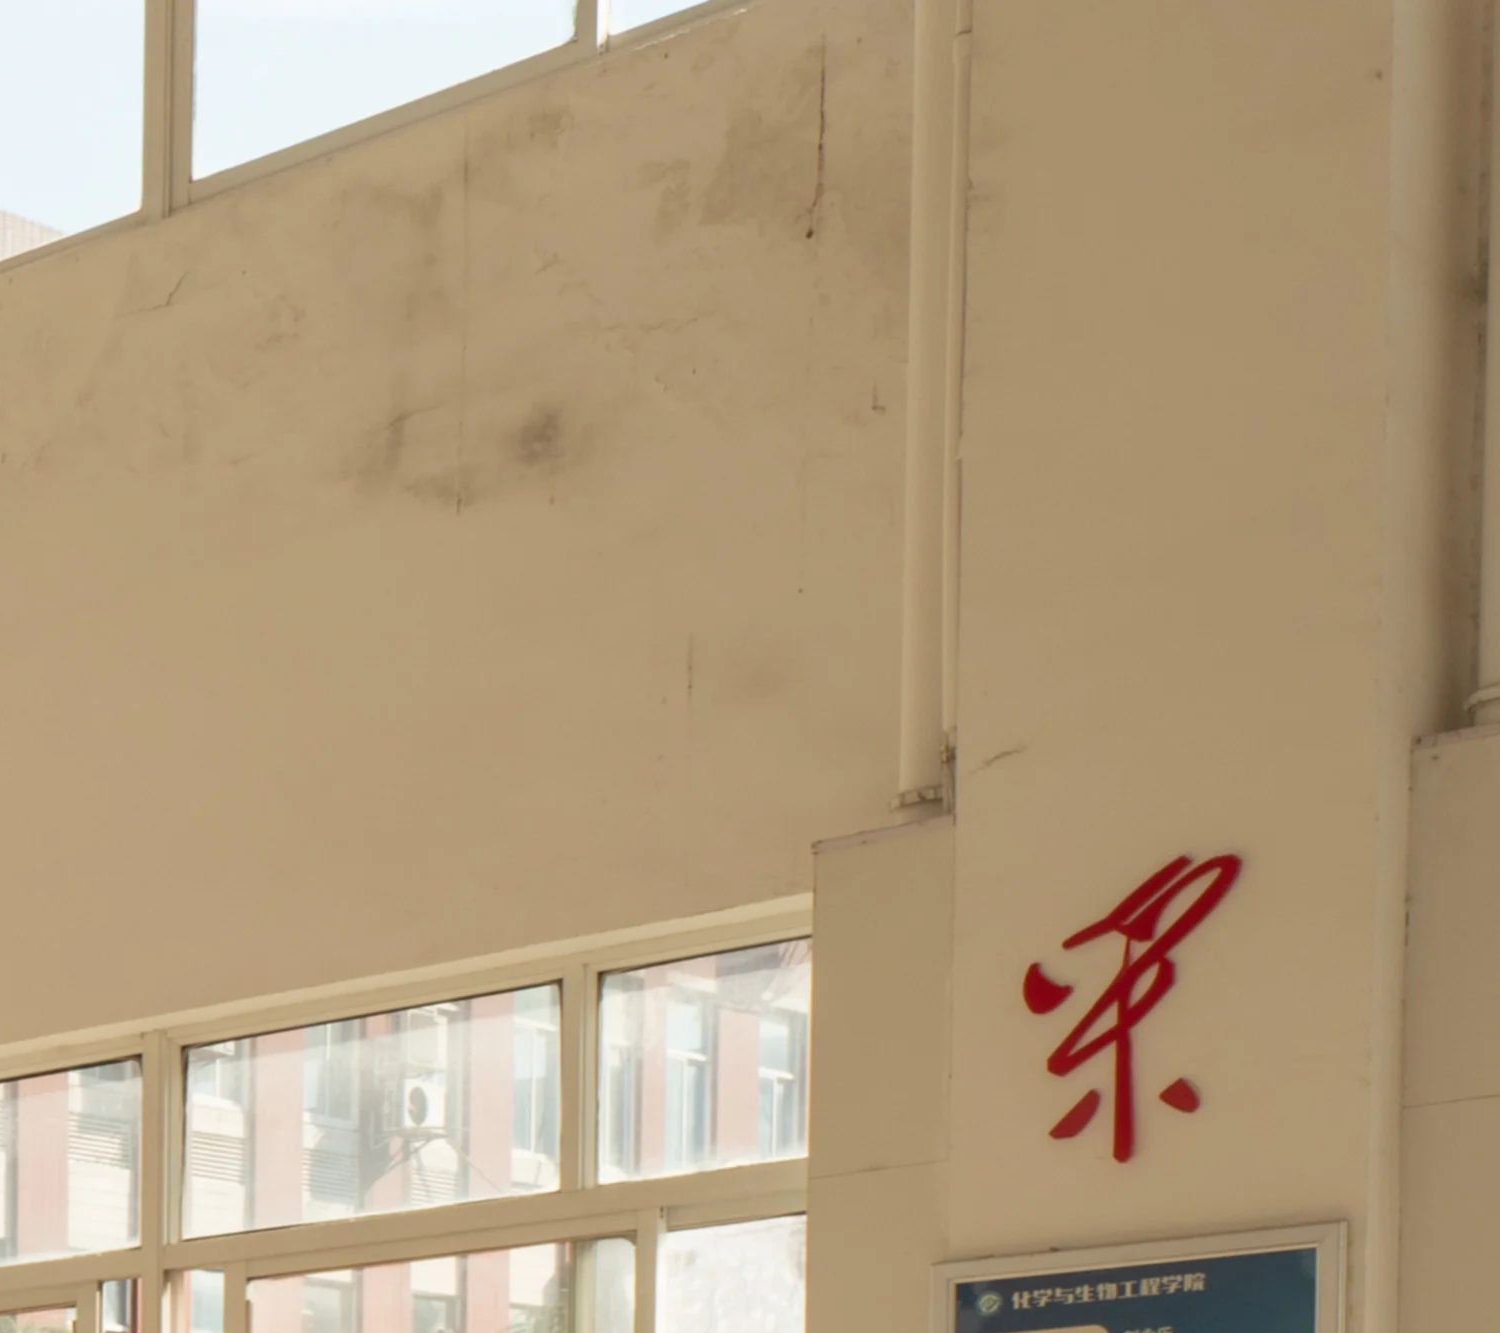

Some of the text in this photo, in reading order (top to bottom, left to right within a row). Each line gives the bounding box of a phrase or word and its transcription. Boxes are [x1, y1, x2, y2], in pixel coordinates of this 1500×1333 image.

[1011, 1272, 1206, 1310] 化学与生物工程学院
